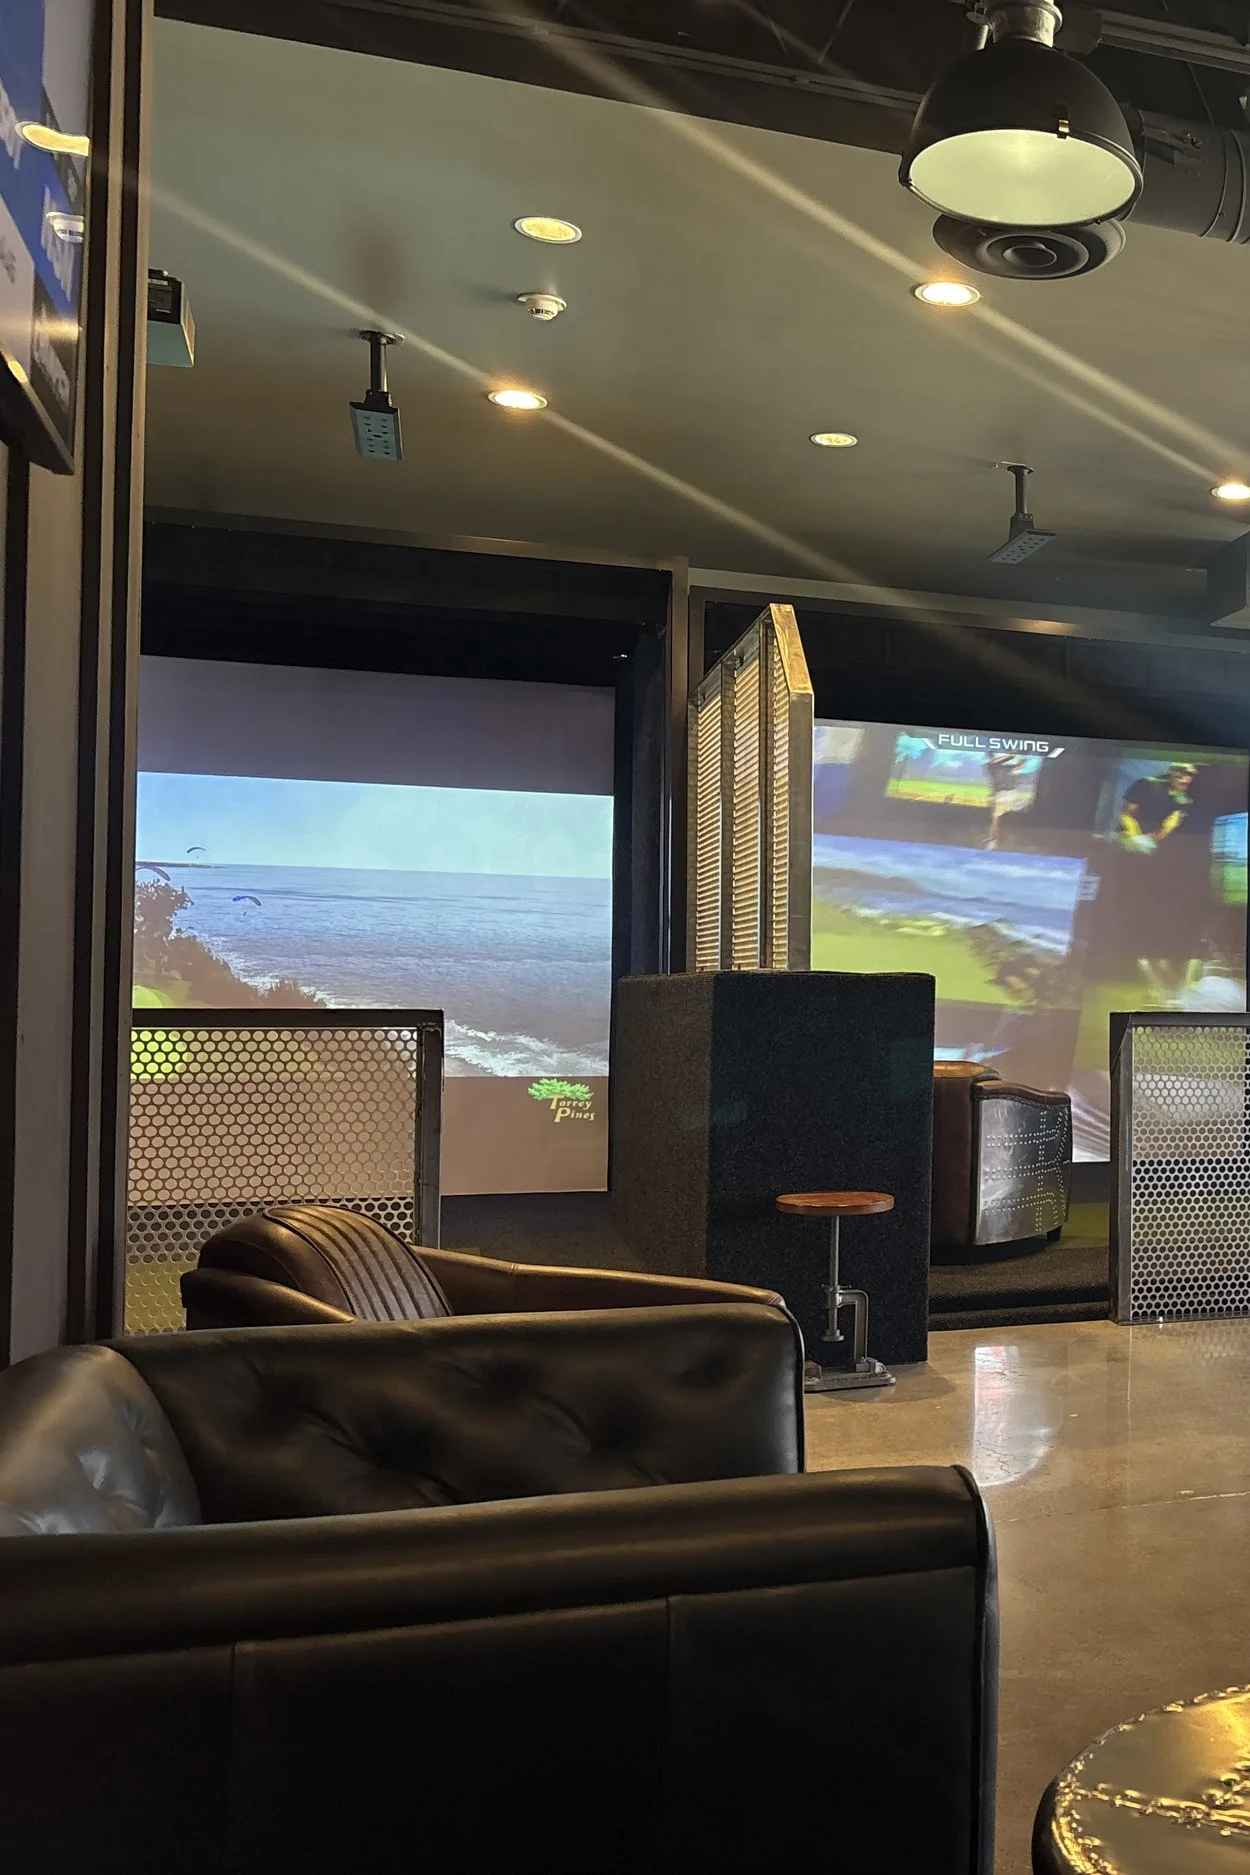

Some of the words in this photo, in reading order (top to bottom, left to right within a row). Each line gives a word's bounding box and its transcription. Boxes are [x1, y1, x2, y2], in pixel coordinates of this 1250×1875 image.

[938, 734, 986, 749] FULL
[989, 737, 1049, 753] SWING
[548, 1094, 592, 1110] Torrey
[554, 1107, 595, 1123] Pines
